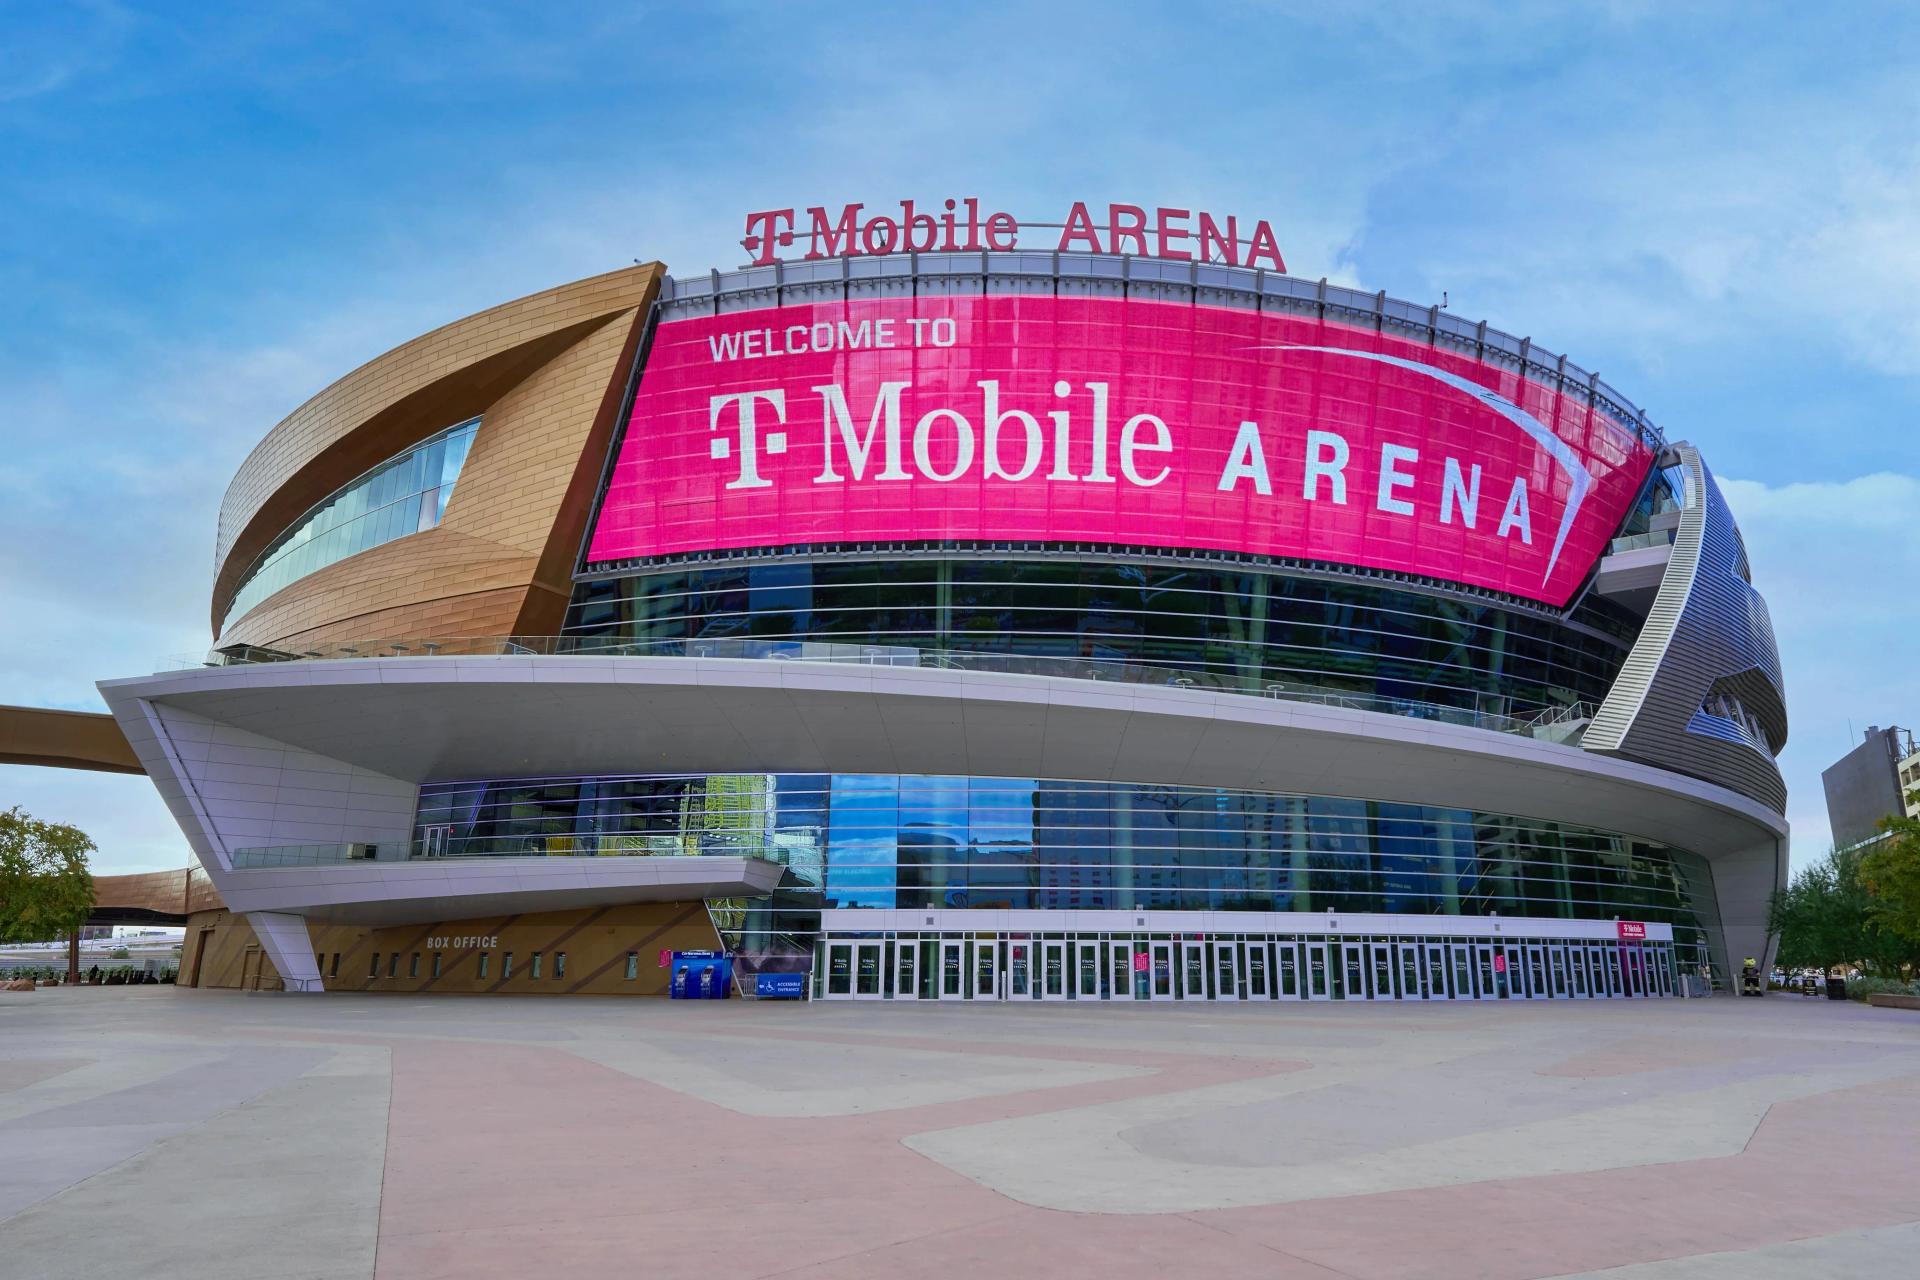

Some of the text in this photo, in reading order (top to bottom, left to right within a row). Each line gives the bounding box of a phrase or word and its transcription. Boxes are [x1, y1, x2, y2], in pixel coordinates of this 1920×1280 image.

[804, 198, 1018, 260] Mobile
[1057, 201, 1287, 274] ARENA
[709, 318, 956, 363] WELCOME TO
[811, 380, 1173, 487] Mobile
[1217, 421, 1532, 545] ARENA
[427, 936, 498, 949] BOX OFFICE
